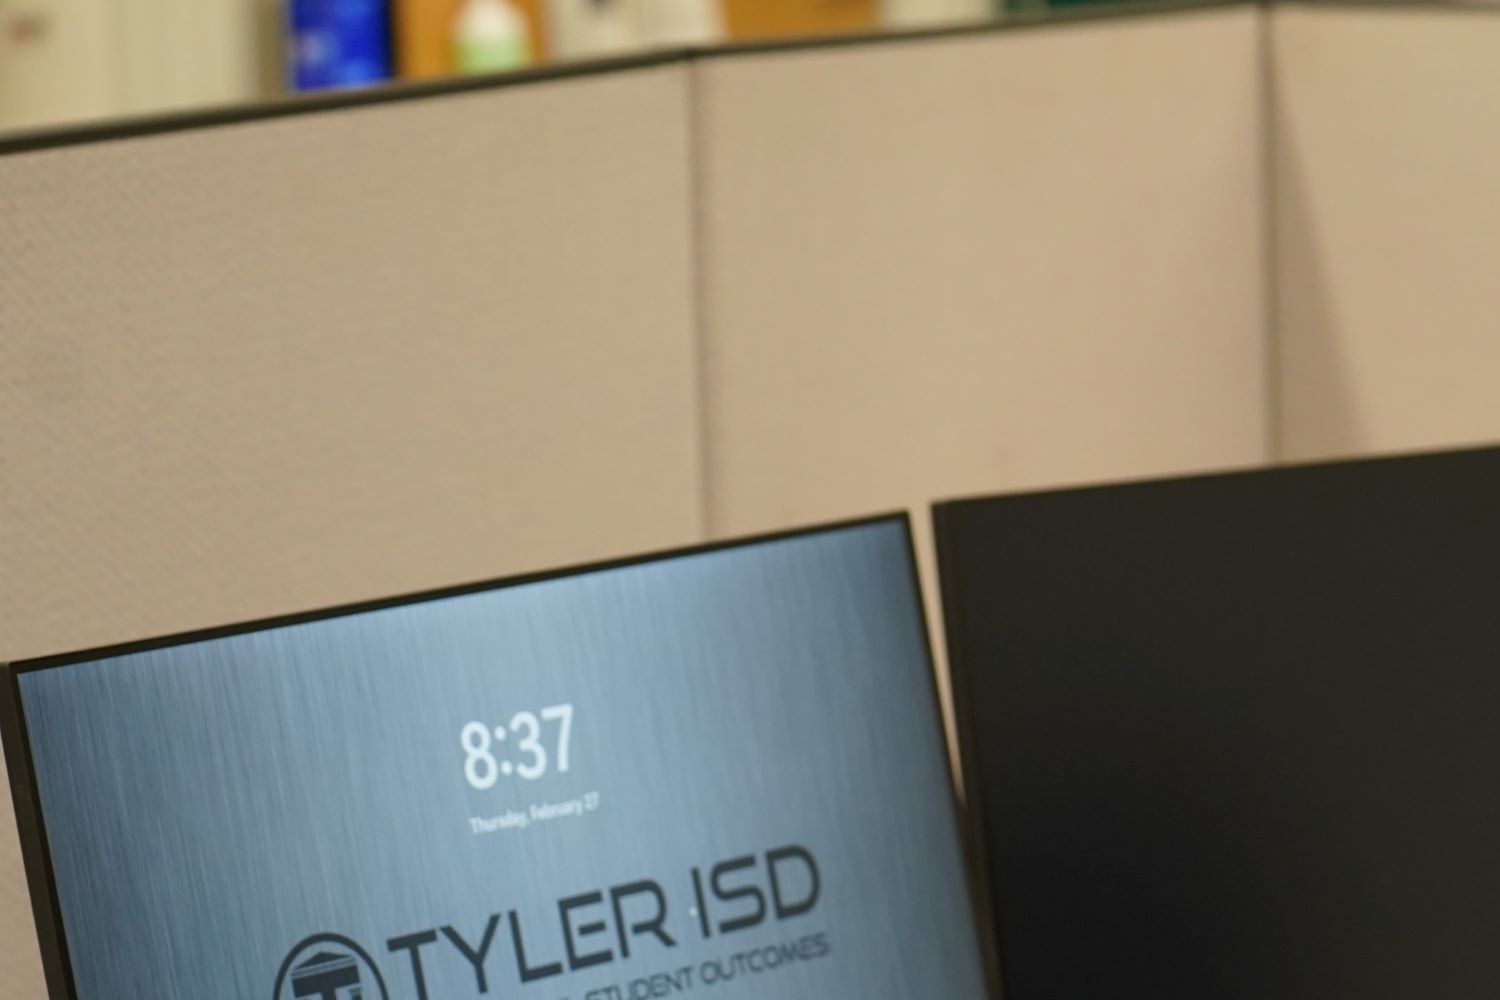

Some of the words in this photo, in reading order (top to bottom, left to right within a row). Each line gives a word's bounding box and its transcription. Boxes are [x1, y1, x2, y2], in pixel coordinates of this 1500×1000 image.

[461, 703, 574, 790] 8:37
[469, 810, 530, 834] Thursday,
[530, 801, 583, 822] February
[583, 791, 600, 811] 27
[690, 844, 822, 938] ISD
[700, 931, 831, 986] OUTCOMES
